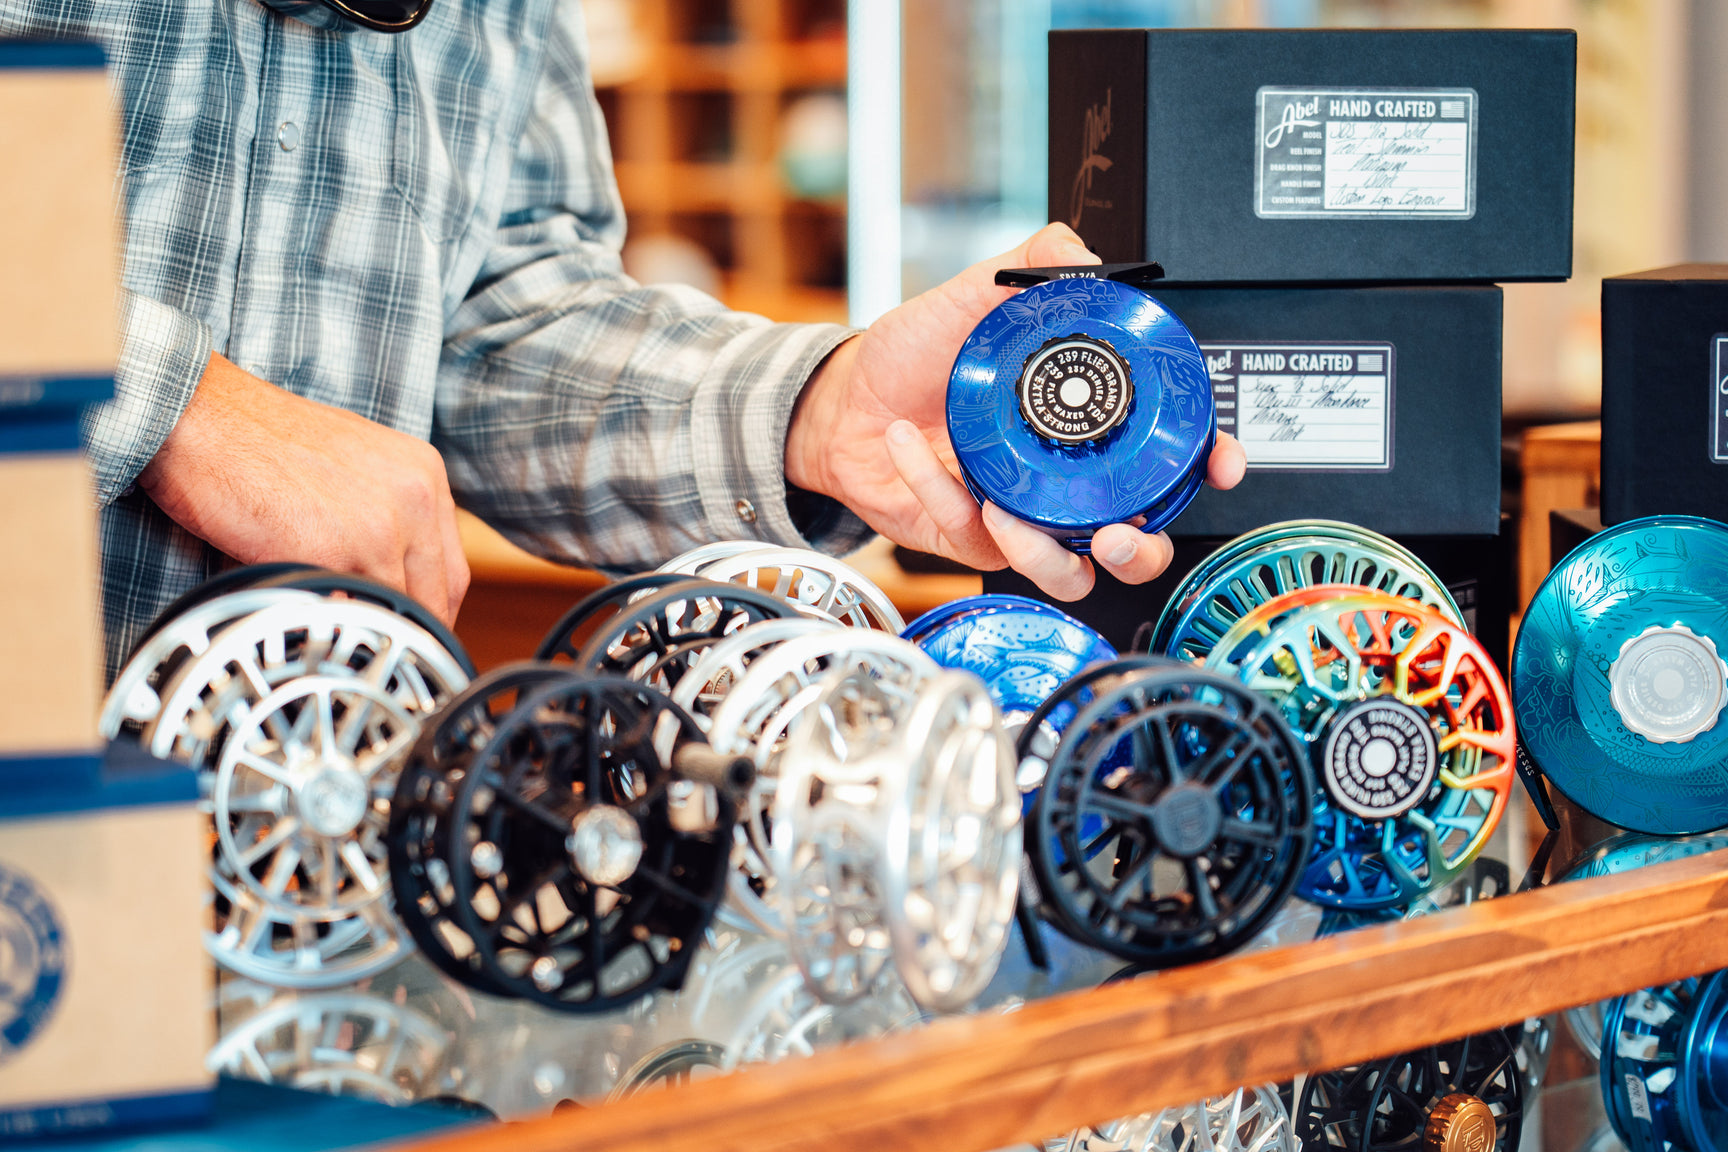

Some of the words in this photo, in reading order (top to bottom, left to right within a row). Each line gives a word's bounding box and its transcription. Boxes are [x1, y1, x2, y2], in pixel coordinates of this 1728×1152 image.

[1265, 96, 1322, 148] Abel
[1329, 100, 1371, 117] HAND
[1375, 100, 1436, 117] CRAFTED
[1057, 350, 1078, 365] 239
[1081, 351, 1109, 373] FLIES
[1105, 371, 1118, 410] BRAND
[1206, 350, 1233, 374] bel
[1242, 353, 1286, 371] HAND
[1288, 353, 1353, 371] CRAFTED
[1044, 361, 1064, 380] 239
[1087, 402, 1106, 422] YDS
[1047, 382, 1056, 404] FLAT
[1053, 404, 1085, 420] WAXED
[1067, 365, 1085, 374] 239
[1087, 369, 1104, 401] DENIER
[1032, 376, 1046, 414] EXTRA
[1043, 413, 1090, 433] STRONG
